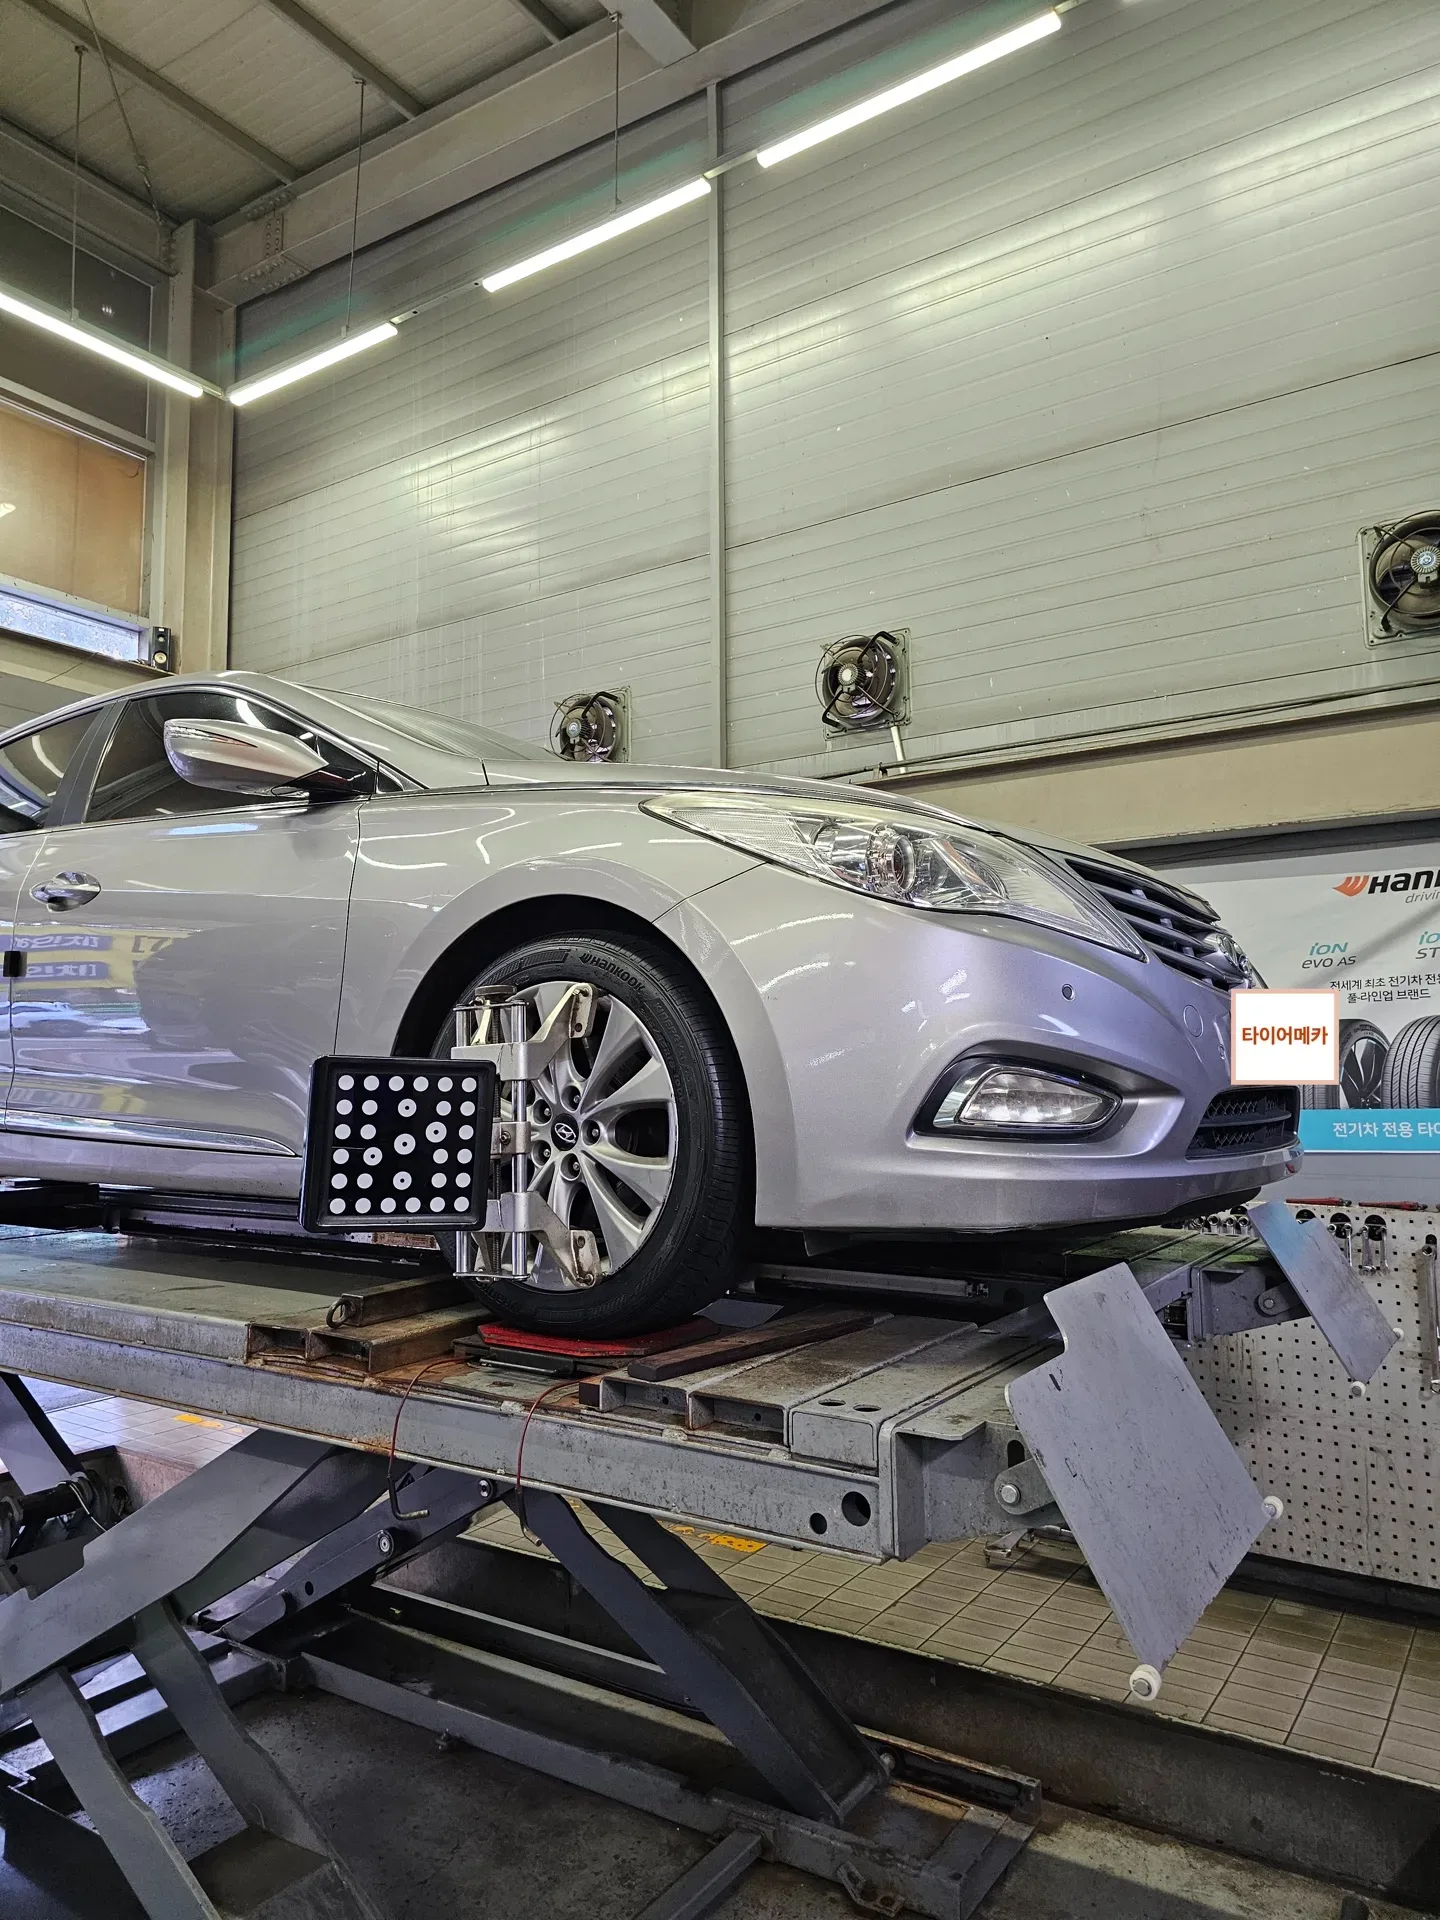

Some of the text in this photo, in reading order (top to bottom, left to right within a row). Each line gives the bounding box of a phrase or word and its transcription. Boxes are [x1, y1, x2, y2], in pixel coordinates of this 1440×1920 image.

[1337, 956, 1357, 967] AS
[1364, 978, 1386, 989] 최초
[1388, 974, 1422, 988] 전기차
[1396, 988, 1431, 1001] 브랜드
[1332, 1121, 1379, 1138] 전기차
[1382, 1121, 1414, 1139] 전용
